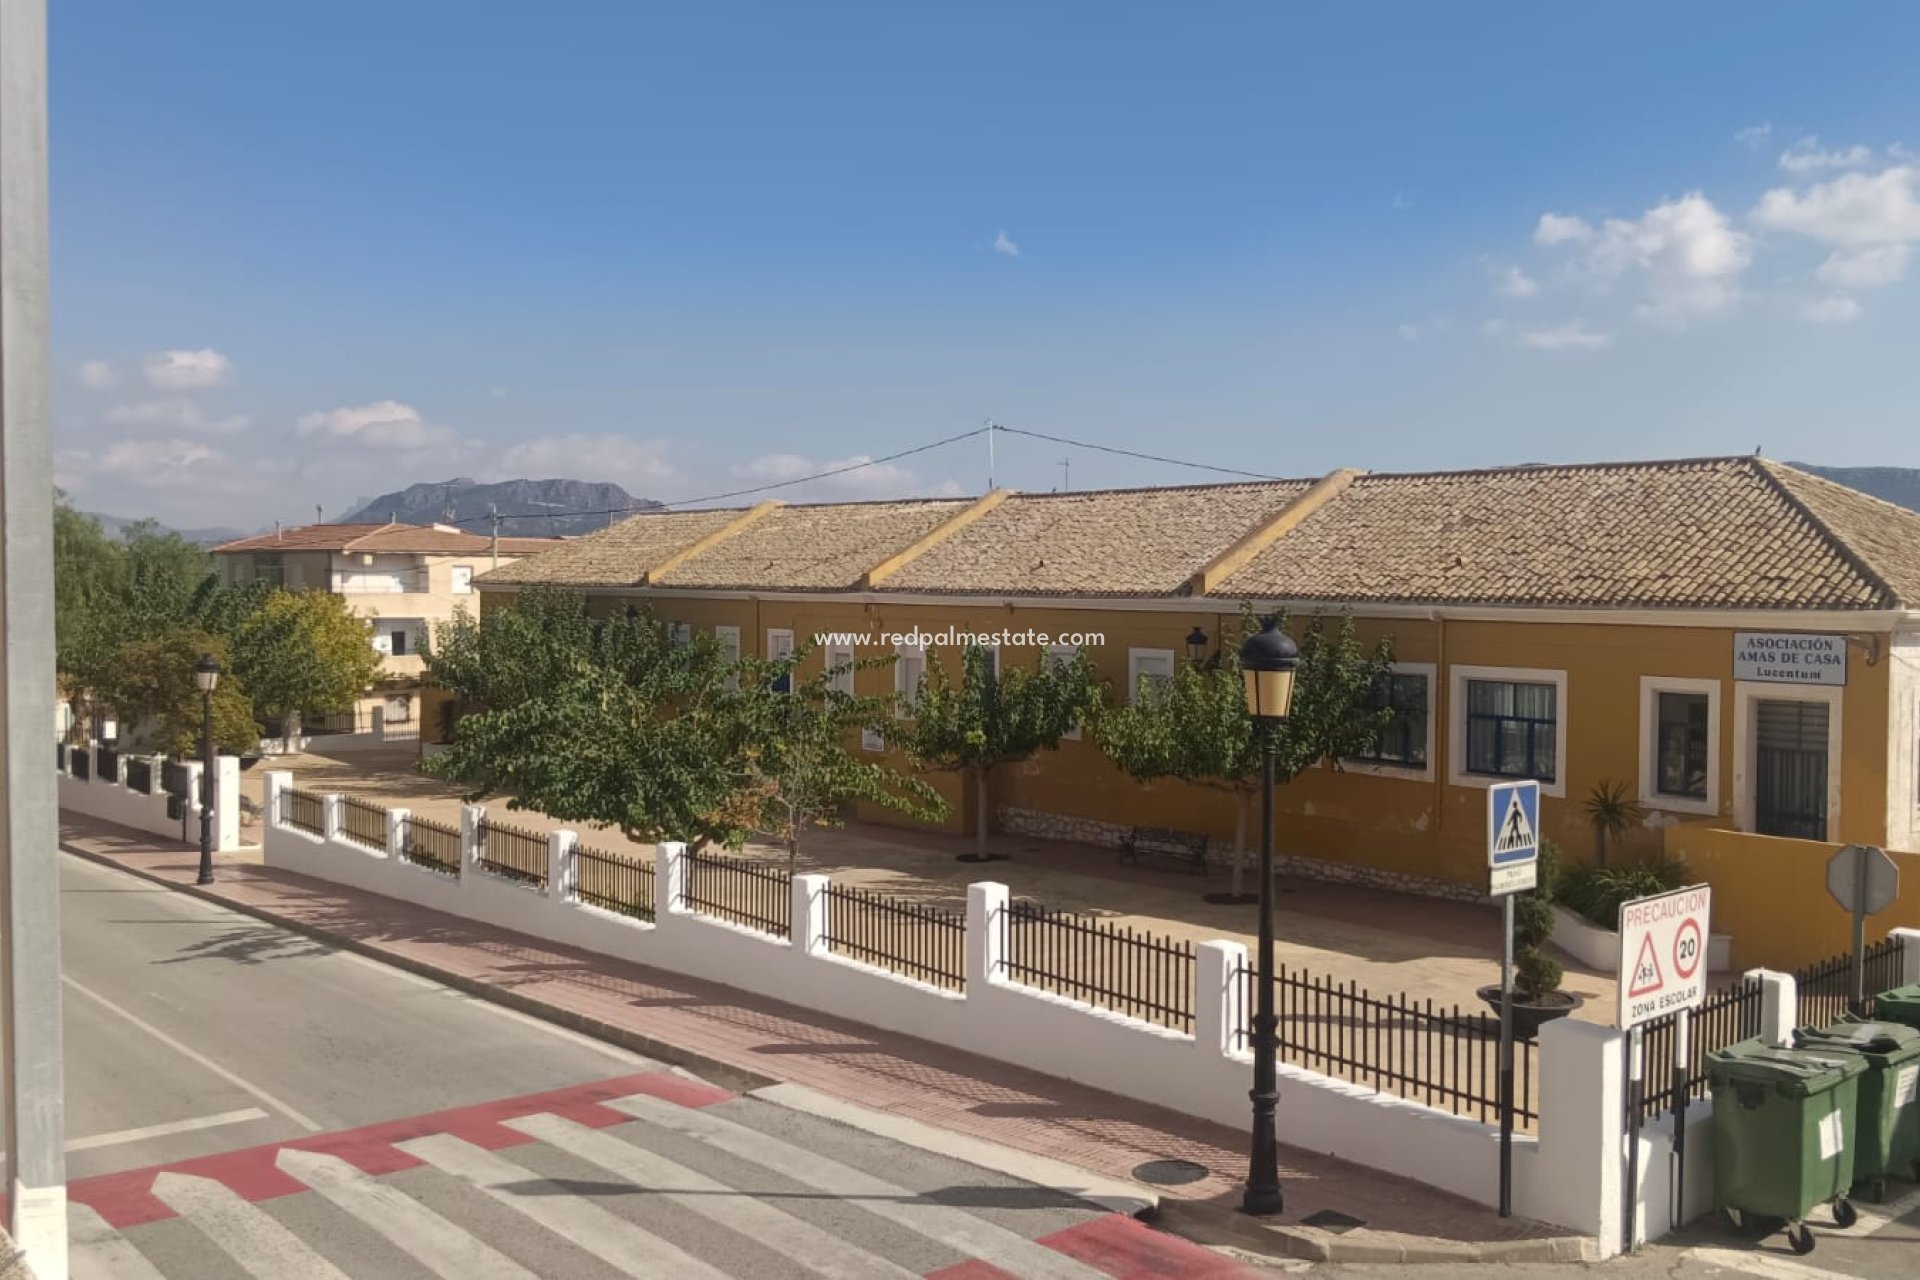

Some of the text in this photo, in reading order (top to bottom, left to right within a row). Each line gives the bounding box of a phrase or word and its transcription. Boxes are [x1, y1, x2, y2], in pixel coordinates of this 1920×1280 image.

[1747, 637, 1833, 651] ASOCIACIÓN
[1738, 651, 1841, 665] AMAS DE CASA
[1679, 938, 1695, 960] 20
[1632, 986, 1698, 1018] ZONA ESCOLAR
